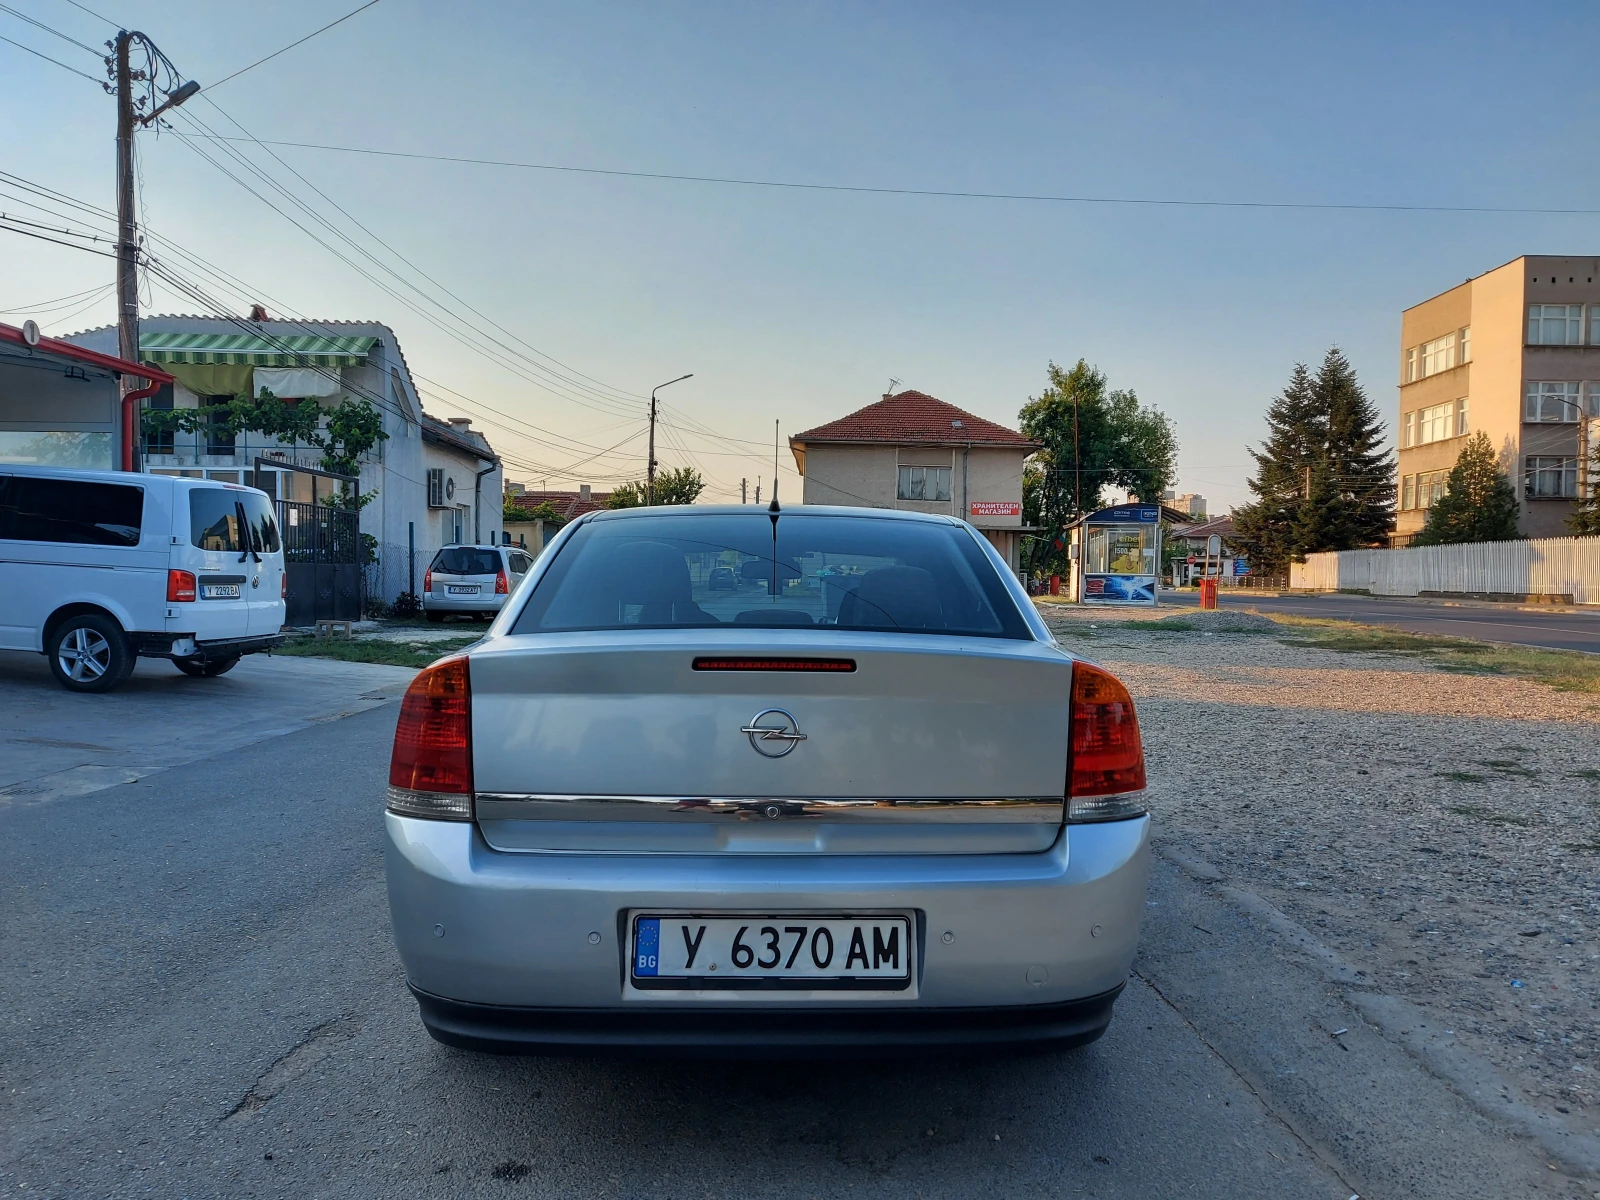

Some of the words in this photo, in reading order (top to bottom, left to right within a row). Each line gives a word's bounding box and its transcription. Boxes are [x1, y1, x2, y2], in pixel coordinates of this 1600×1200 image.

[29, 323, 35, 343] 1
[730, 925, 834, 970] 6370
[845, 926, 900, 970] AM
[638, 954, 657, 969] BG
